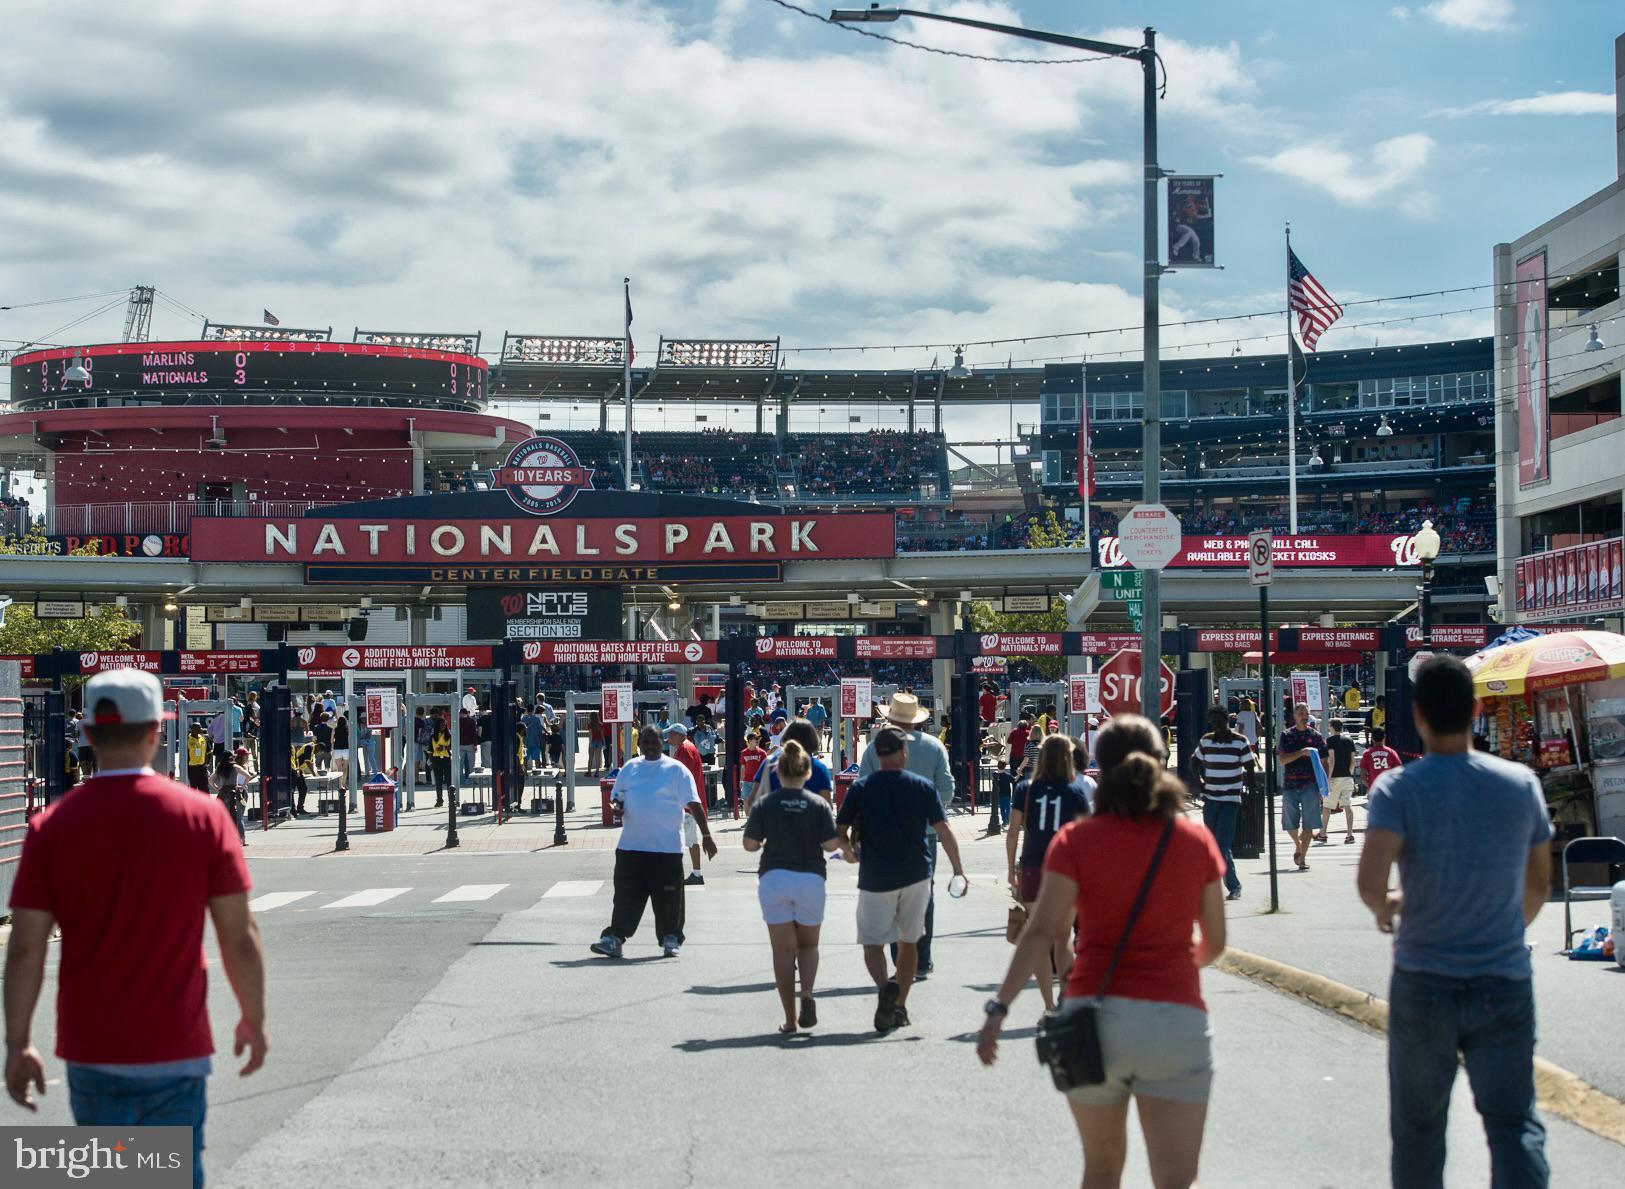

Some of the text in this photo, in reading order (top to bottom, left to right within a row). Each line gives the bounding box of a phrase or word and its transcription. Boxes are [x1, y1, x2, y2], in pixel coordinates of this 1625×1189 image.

[142, 353, 247, 368] MARLINS 0
[450, 363, 457, 378] 0
[142, 369, 246, 385] NATIONALS 3
[41, 377, 48, 393] 3
[450, 379, 457, 394] 3
[512, 442, 543, 466] NATIONALS
[513, 470, 572, 482] 10 YEARS
[265, 523, 640, 556] NATIONALS
[664, 520, 820, 554] PARK
[1204, 540, 1224, 549] WEB
[1226, 540, 1233, 549] &
[1294, 540, 1319, 549] CALL
[1187, 551, 1241, 561] AVAILABLE
[1271, 551, 1296, 561] CKET
[1298, 551, 1336, 561] KIOSKS
[431, 567, 658, 582] CENTER FIELD GATE
[1113, 573, 1122, 587] N
[527, 592, 588, 603] NATS
[1115, 589, 1142, 599] UNIT
[527, 604, 588, 615] PLUS
[1128, 602, 1142, 616] HAL
[509, 626, 579, 637] SECTION 139
[1201, 632, 1274, 641] EXPRESS ENTRAE
[1301, 632, 1375, 641] EXPRESS ENTRANCE
[775, 640, 821, 648] WELCOME TO
[1000, 636, 1046, 645] WELCOME TO
[1431, 634, 1463, 643] NTRANCE
[364, 647, 447, 658] ADDITIONAL GATES AT
[553, 643, 681, 653] ADDITIONAL GATES AT LEFT FIELD,
[815, 647, 834, 655] PARK
[1000, 644, 1039, 652] NATIONALS
[100, 654, 146, 663] WELCOME TO
[364, 657, 476, 668] RIGHT FIELD AND FIRST BASE
[553, 653, 665, 663] THIRD BASE AND HOME PLATE
[100, 662, 138, 670] NATIONALS
[1373, 757, 1389, 770] 24
[375, 797, 384, 829] TRASH
[1035, 794, 1062, 831] 11
